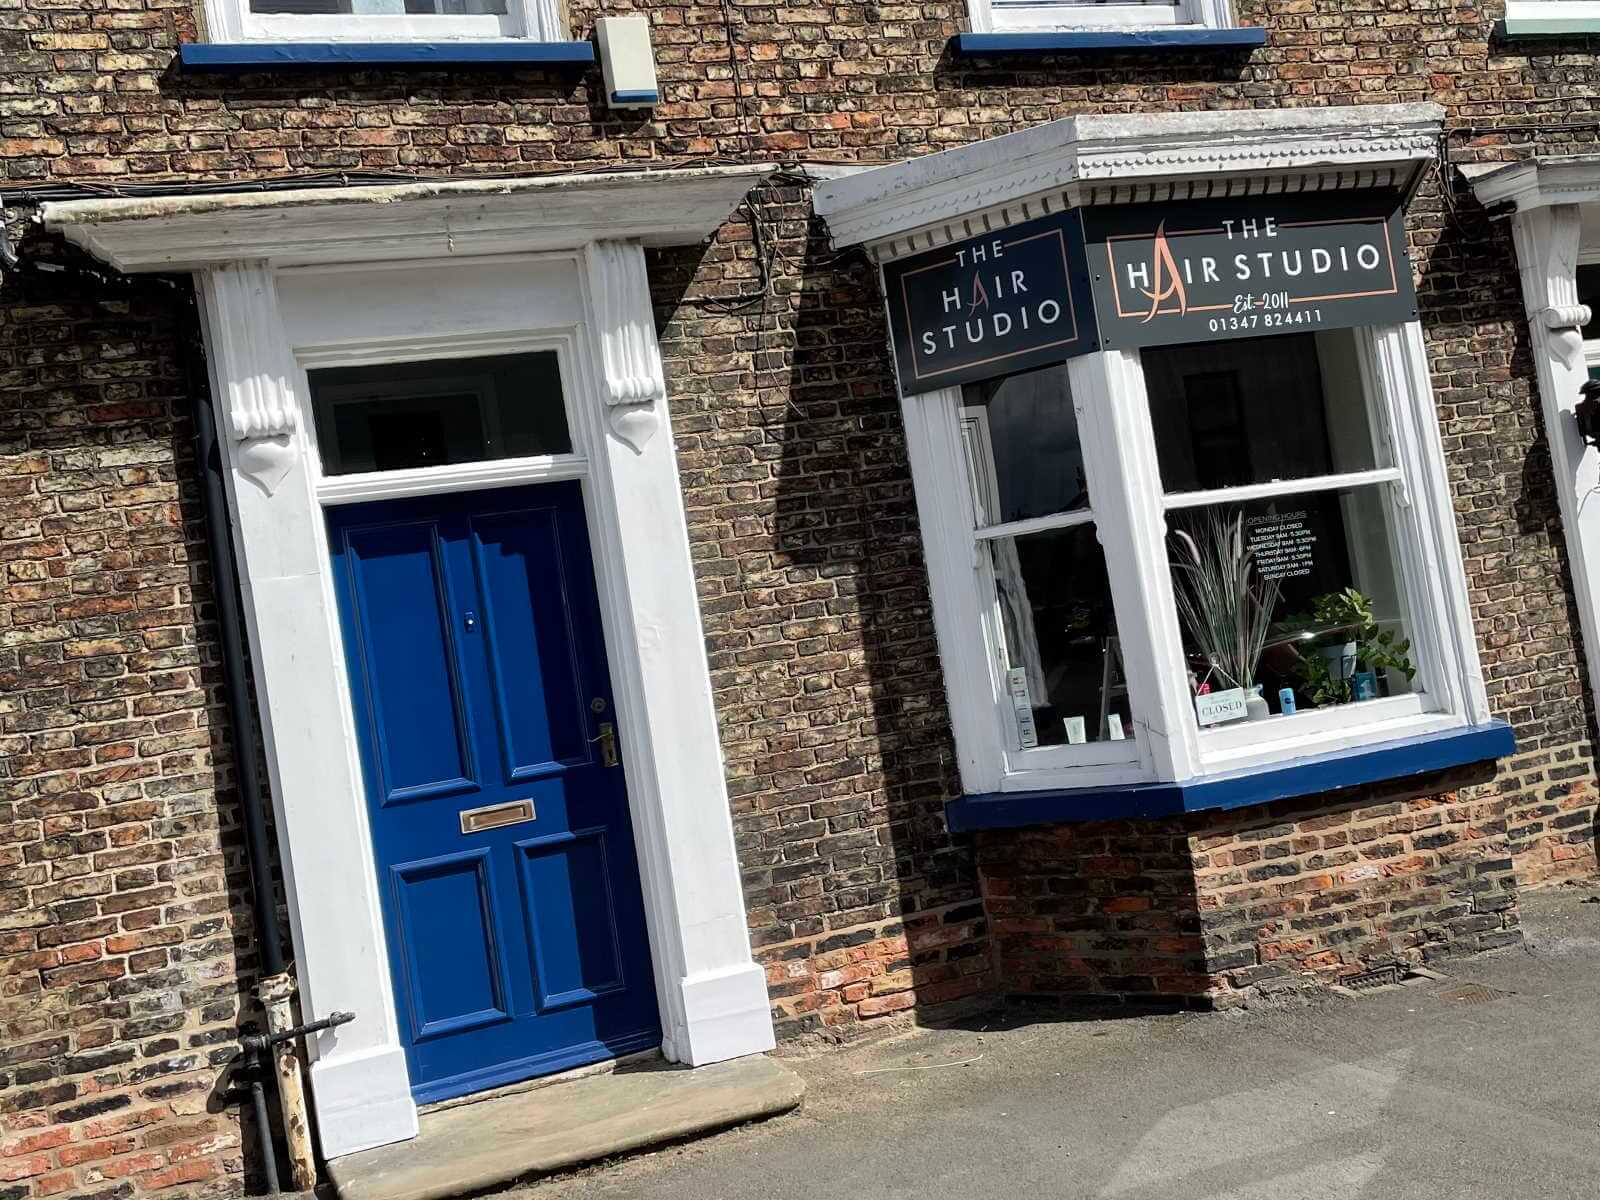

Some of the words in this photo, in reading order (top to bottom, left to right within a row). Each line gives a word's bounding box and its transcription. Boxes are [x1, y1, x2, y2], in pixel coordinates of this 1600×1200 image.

[1222, 217, 1279, 240] THE
[955, 240, 1004, 268] THE
[1234, 244, 1380, 281] STUDIO
[942, 270, 1029, 317] HAIR
[1233, 293, 1256, 314] Est.
[1262, 291, 1289, 310] 2011
[922, 299, 1061, 355] STUDIO
[1209, 315, 1258, 332] 01347
[1264, 309, 1321, 327] 824411
[1250, 534, 1275, 543] TUESDAY
[1255, 526, 1279, 534] MONDAY
[1280, 522, 1303, 531] CLOSED
[1256, 558, 1276, 566] FRIDAY
[1257, 565, 1286, 573] SATURDAY
[1263, 572, 1286, 580] SUNDAY
[1286, 569, 1310, 577] CLOSED
[1201, 700, 1242, 716] CLOSED
